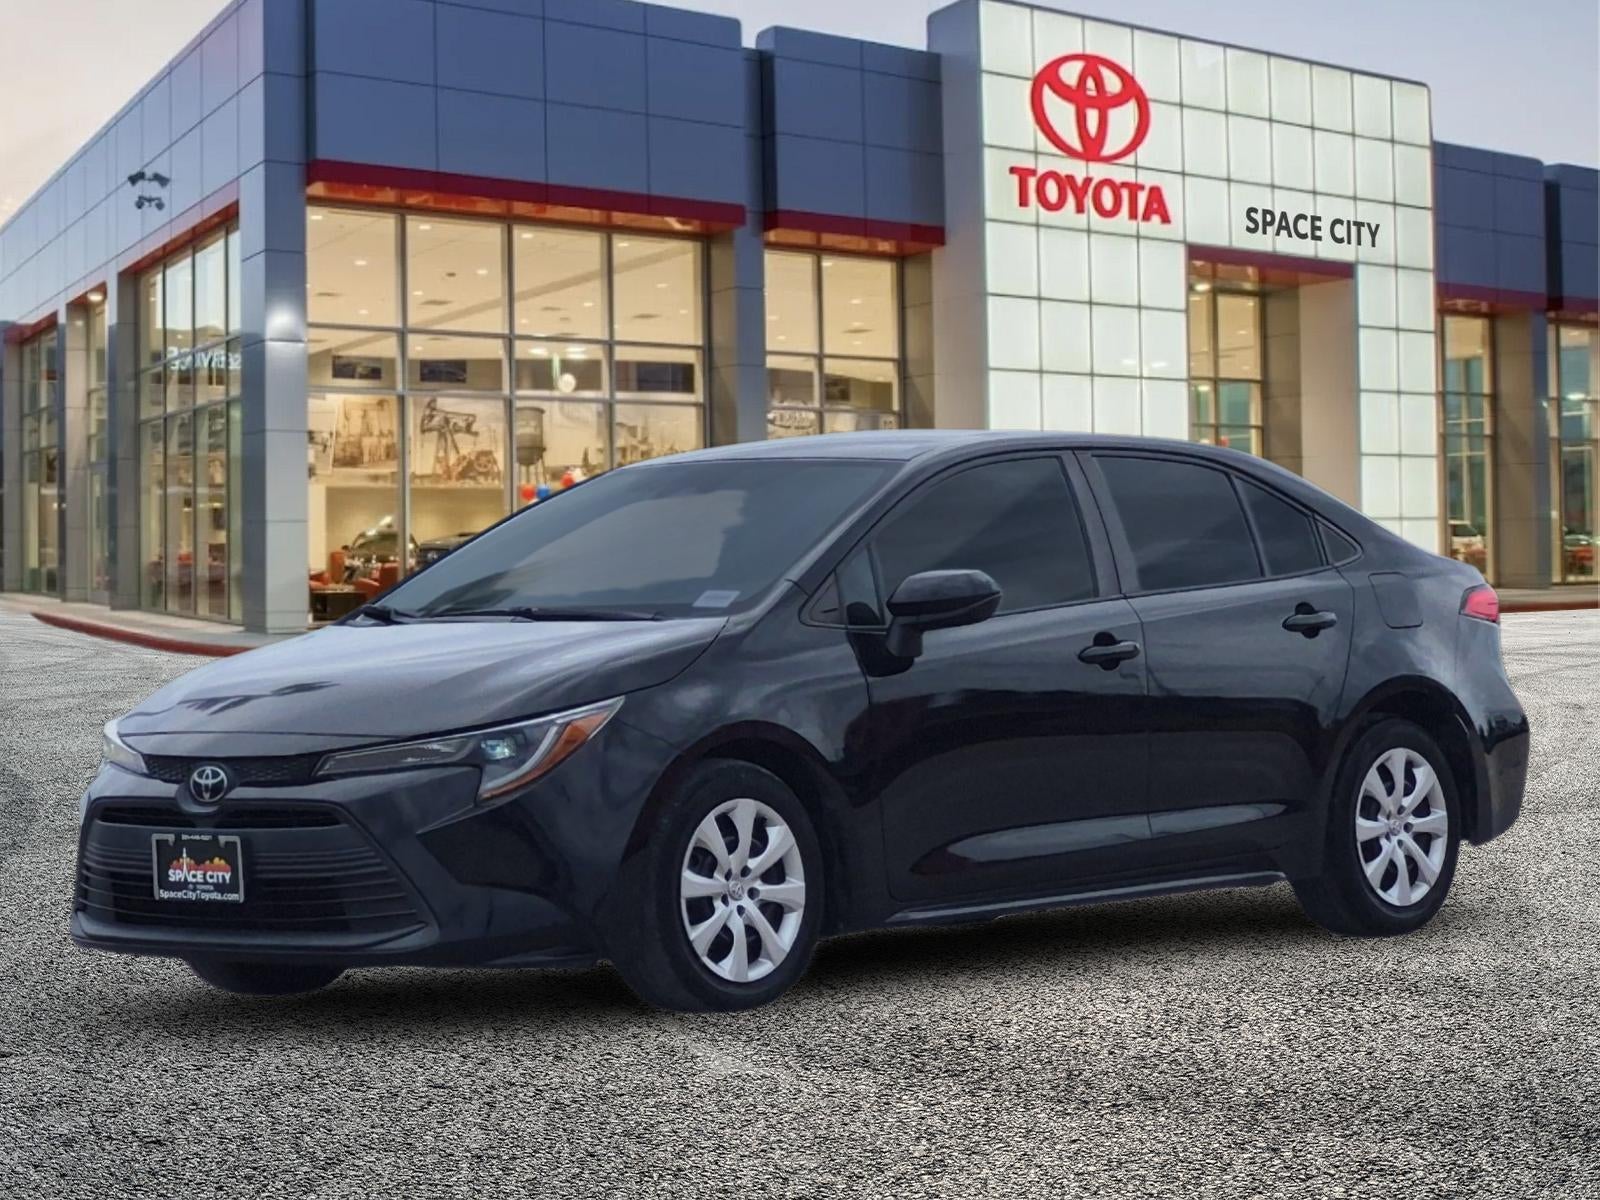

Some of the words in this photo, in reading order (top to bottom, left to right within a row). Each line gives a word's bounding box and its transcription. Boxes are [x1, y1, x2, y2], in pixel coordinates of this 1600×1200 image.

[1009, 166, 1171, 224] TOYOTA
[1245, 207, 1322, 241] SPACE
[1329, 218, 1380, 247] CITY
[168, 868, 204, 882] SPACE
[206, 871, 231, 883] CITY
[160, 889, 239, 900] SpaceCityToyota.com
